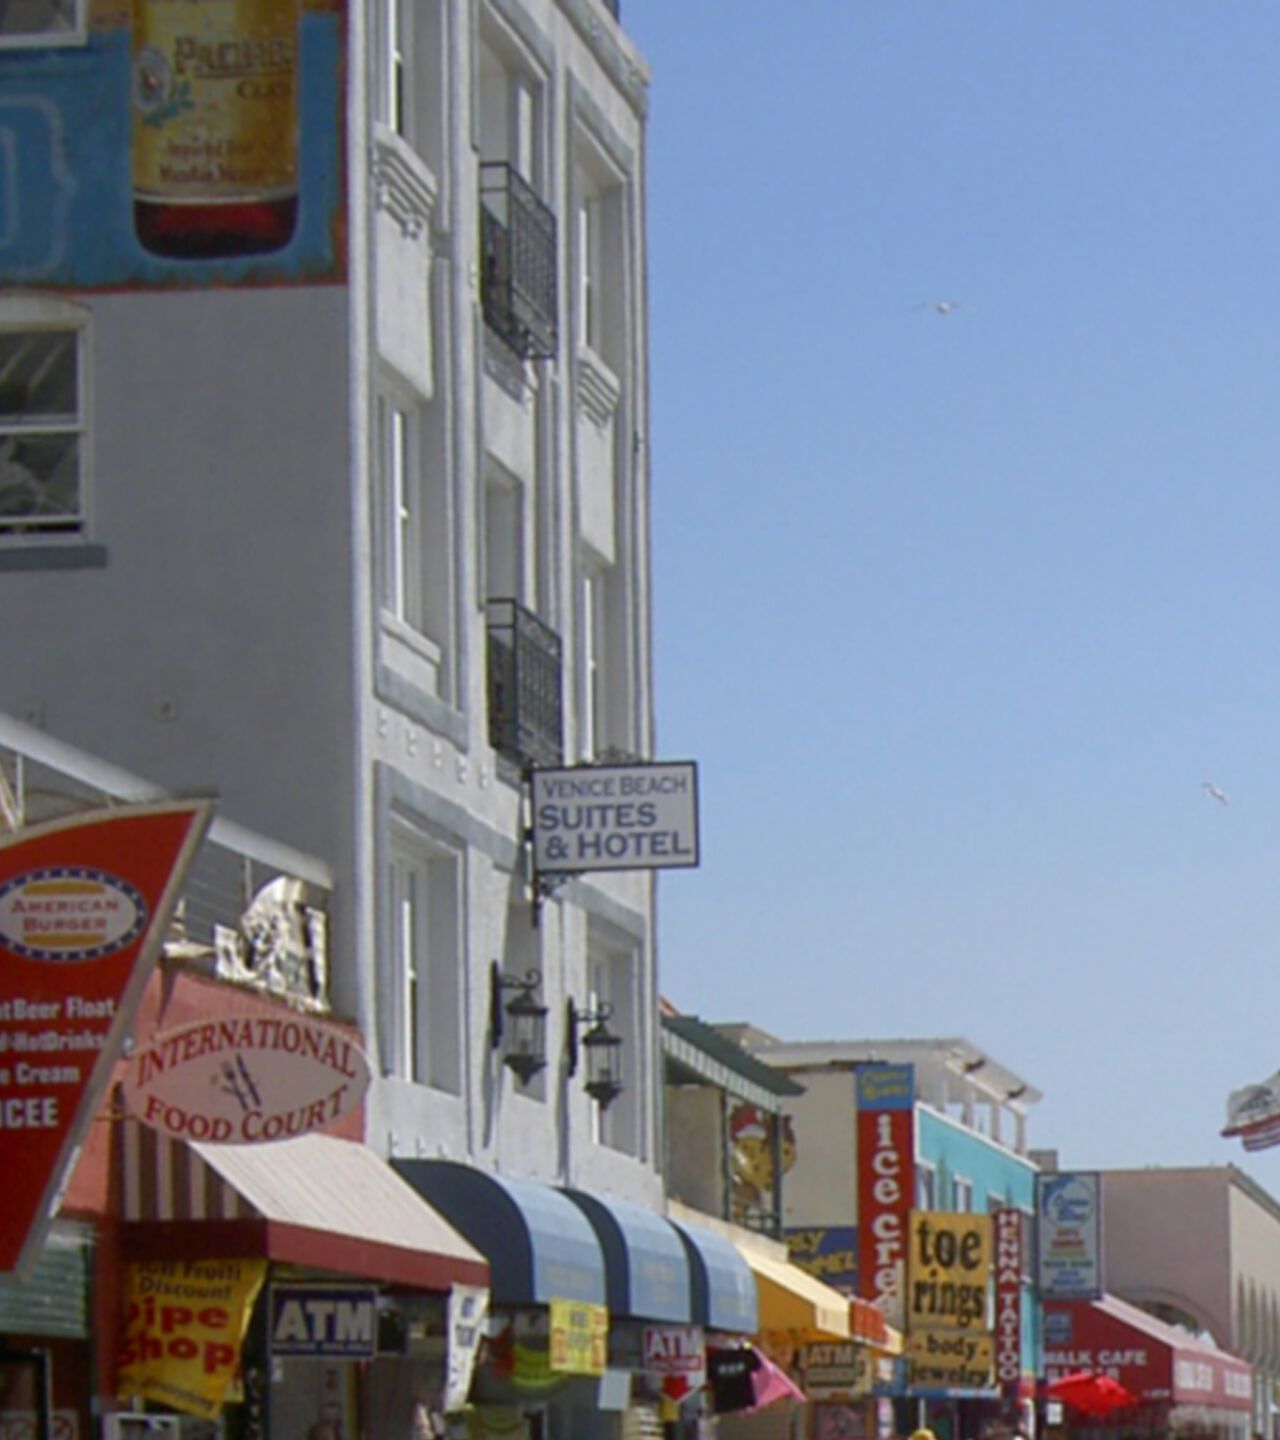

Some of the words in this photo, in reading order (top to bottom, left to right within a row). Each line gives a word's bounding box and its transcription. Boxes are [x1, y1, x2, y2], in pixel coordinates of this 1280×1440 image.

[543, 778, 615, 798] VENICE
[620, 775, 688, 796] BEACH
[539, 803, 657, 830] SUITES
[545, 836, 569, 859] &
[578, 832, 691, 858] HOTEL
[11, 900, 119, 914] AMERICAN
[22, 917, 108, 932] BURGER
[13, 998, 61, 1020] Beer
[66, 996, 115, 1018] Float
[136, 1018, 357, 1088] INTERNATIONAL
[15, 1062, 81, 1084] Cream
[143, 1095, 233, 1142] FOOD
[240, 1084, 349, 1142] COURT
[872, 1114, 901, 1205] ice
[916, 1219, 982, 1271] toe
[998, 1212, 1019, 1283] HENNA
[139, 1277, 233, 1301] Discount
[912, 1269, 984, 1328] rings
[274, 1299, 374, 1342] ATM
[649, 1329, 697, 1358] ATM
[926, 1334, 977, 1362] body
[998, 1293, 1019, 1381] TATTOO
[808, 1344, 852, 1365] ATM
[1098, 1349, 1148, 1367] CAFE
